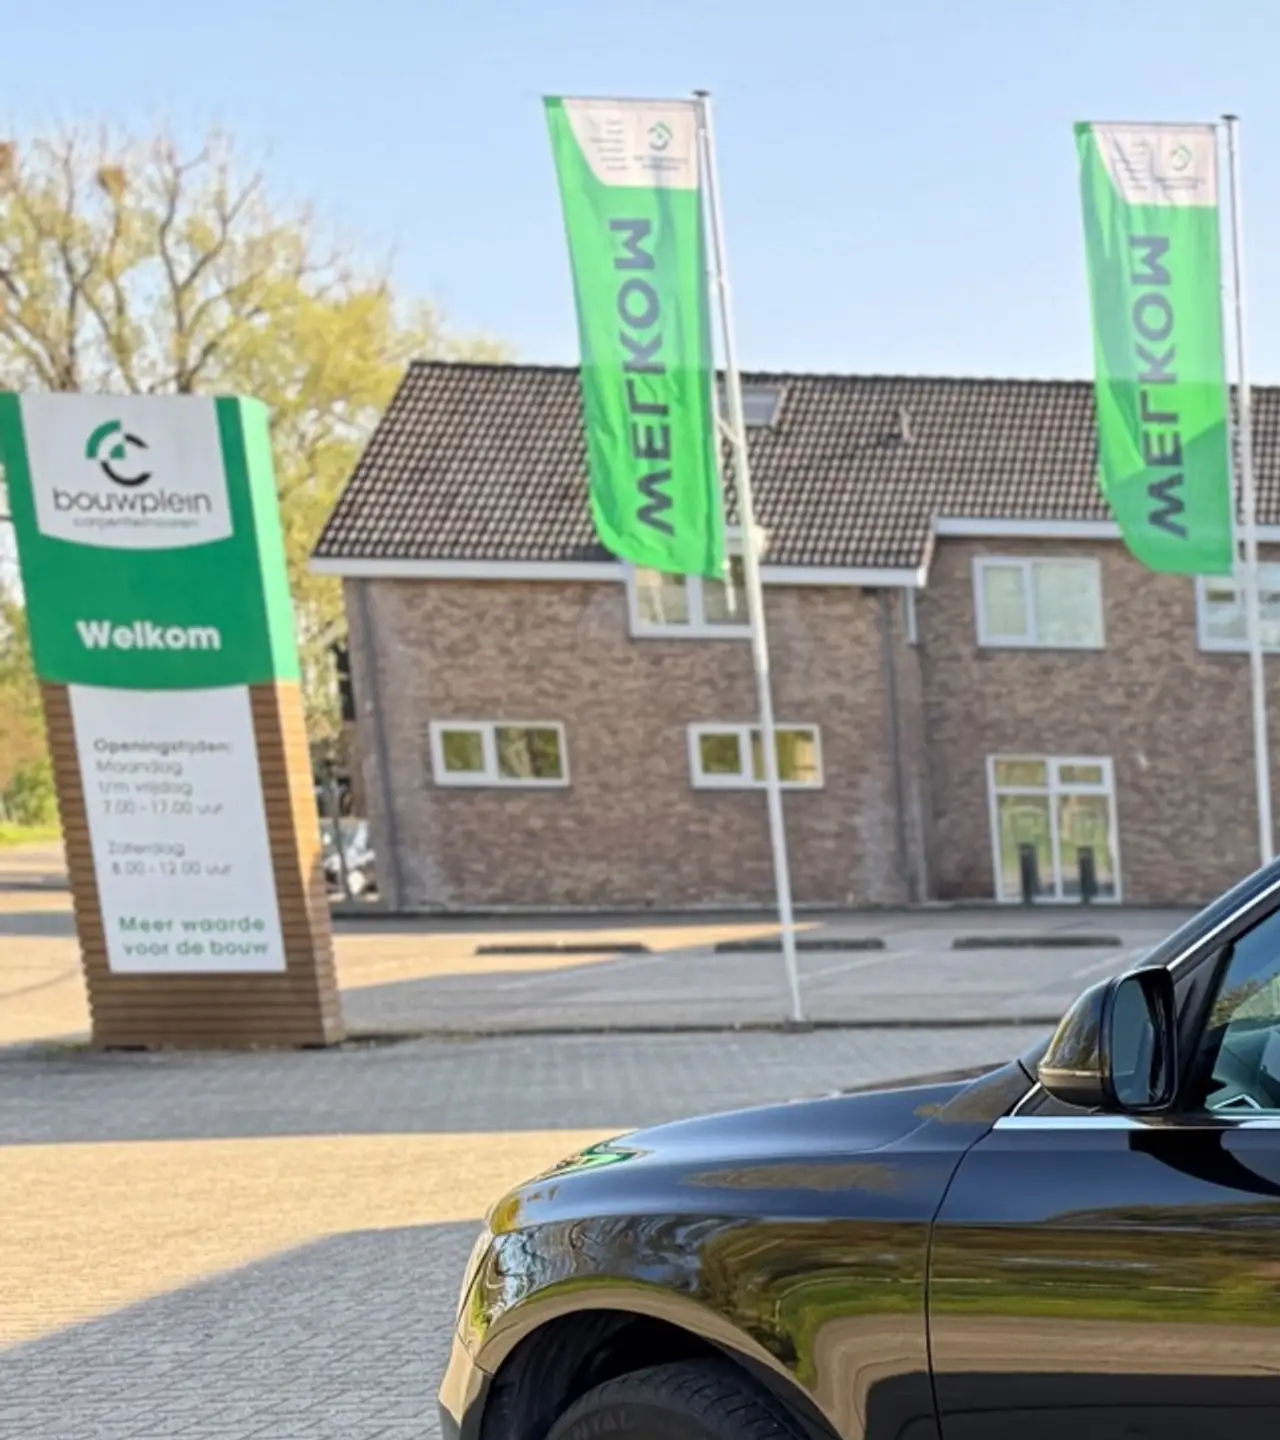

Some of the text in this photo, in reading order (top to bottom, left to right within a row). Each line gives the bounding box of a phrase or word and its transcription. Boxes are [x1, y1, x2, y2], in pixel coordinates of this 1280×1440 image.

[52, 488, 213, 514] bouwplein
[76, 620, 221, 650] Welkom
[95, 760, 184, 776] Maandag
[118, 915, 266, 932] Meer waarde
[123, 940, 269, 956] voor de bouw
